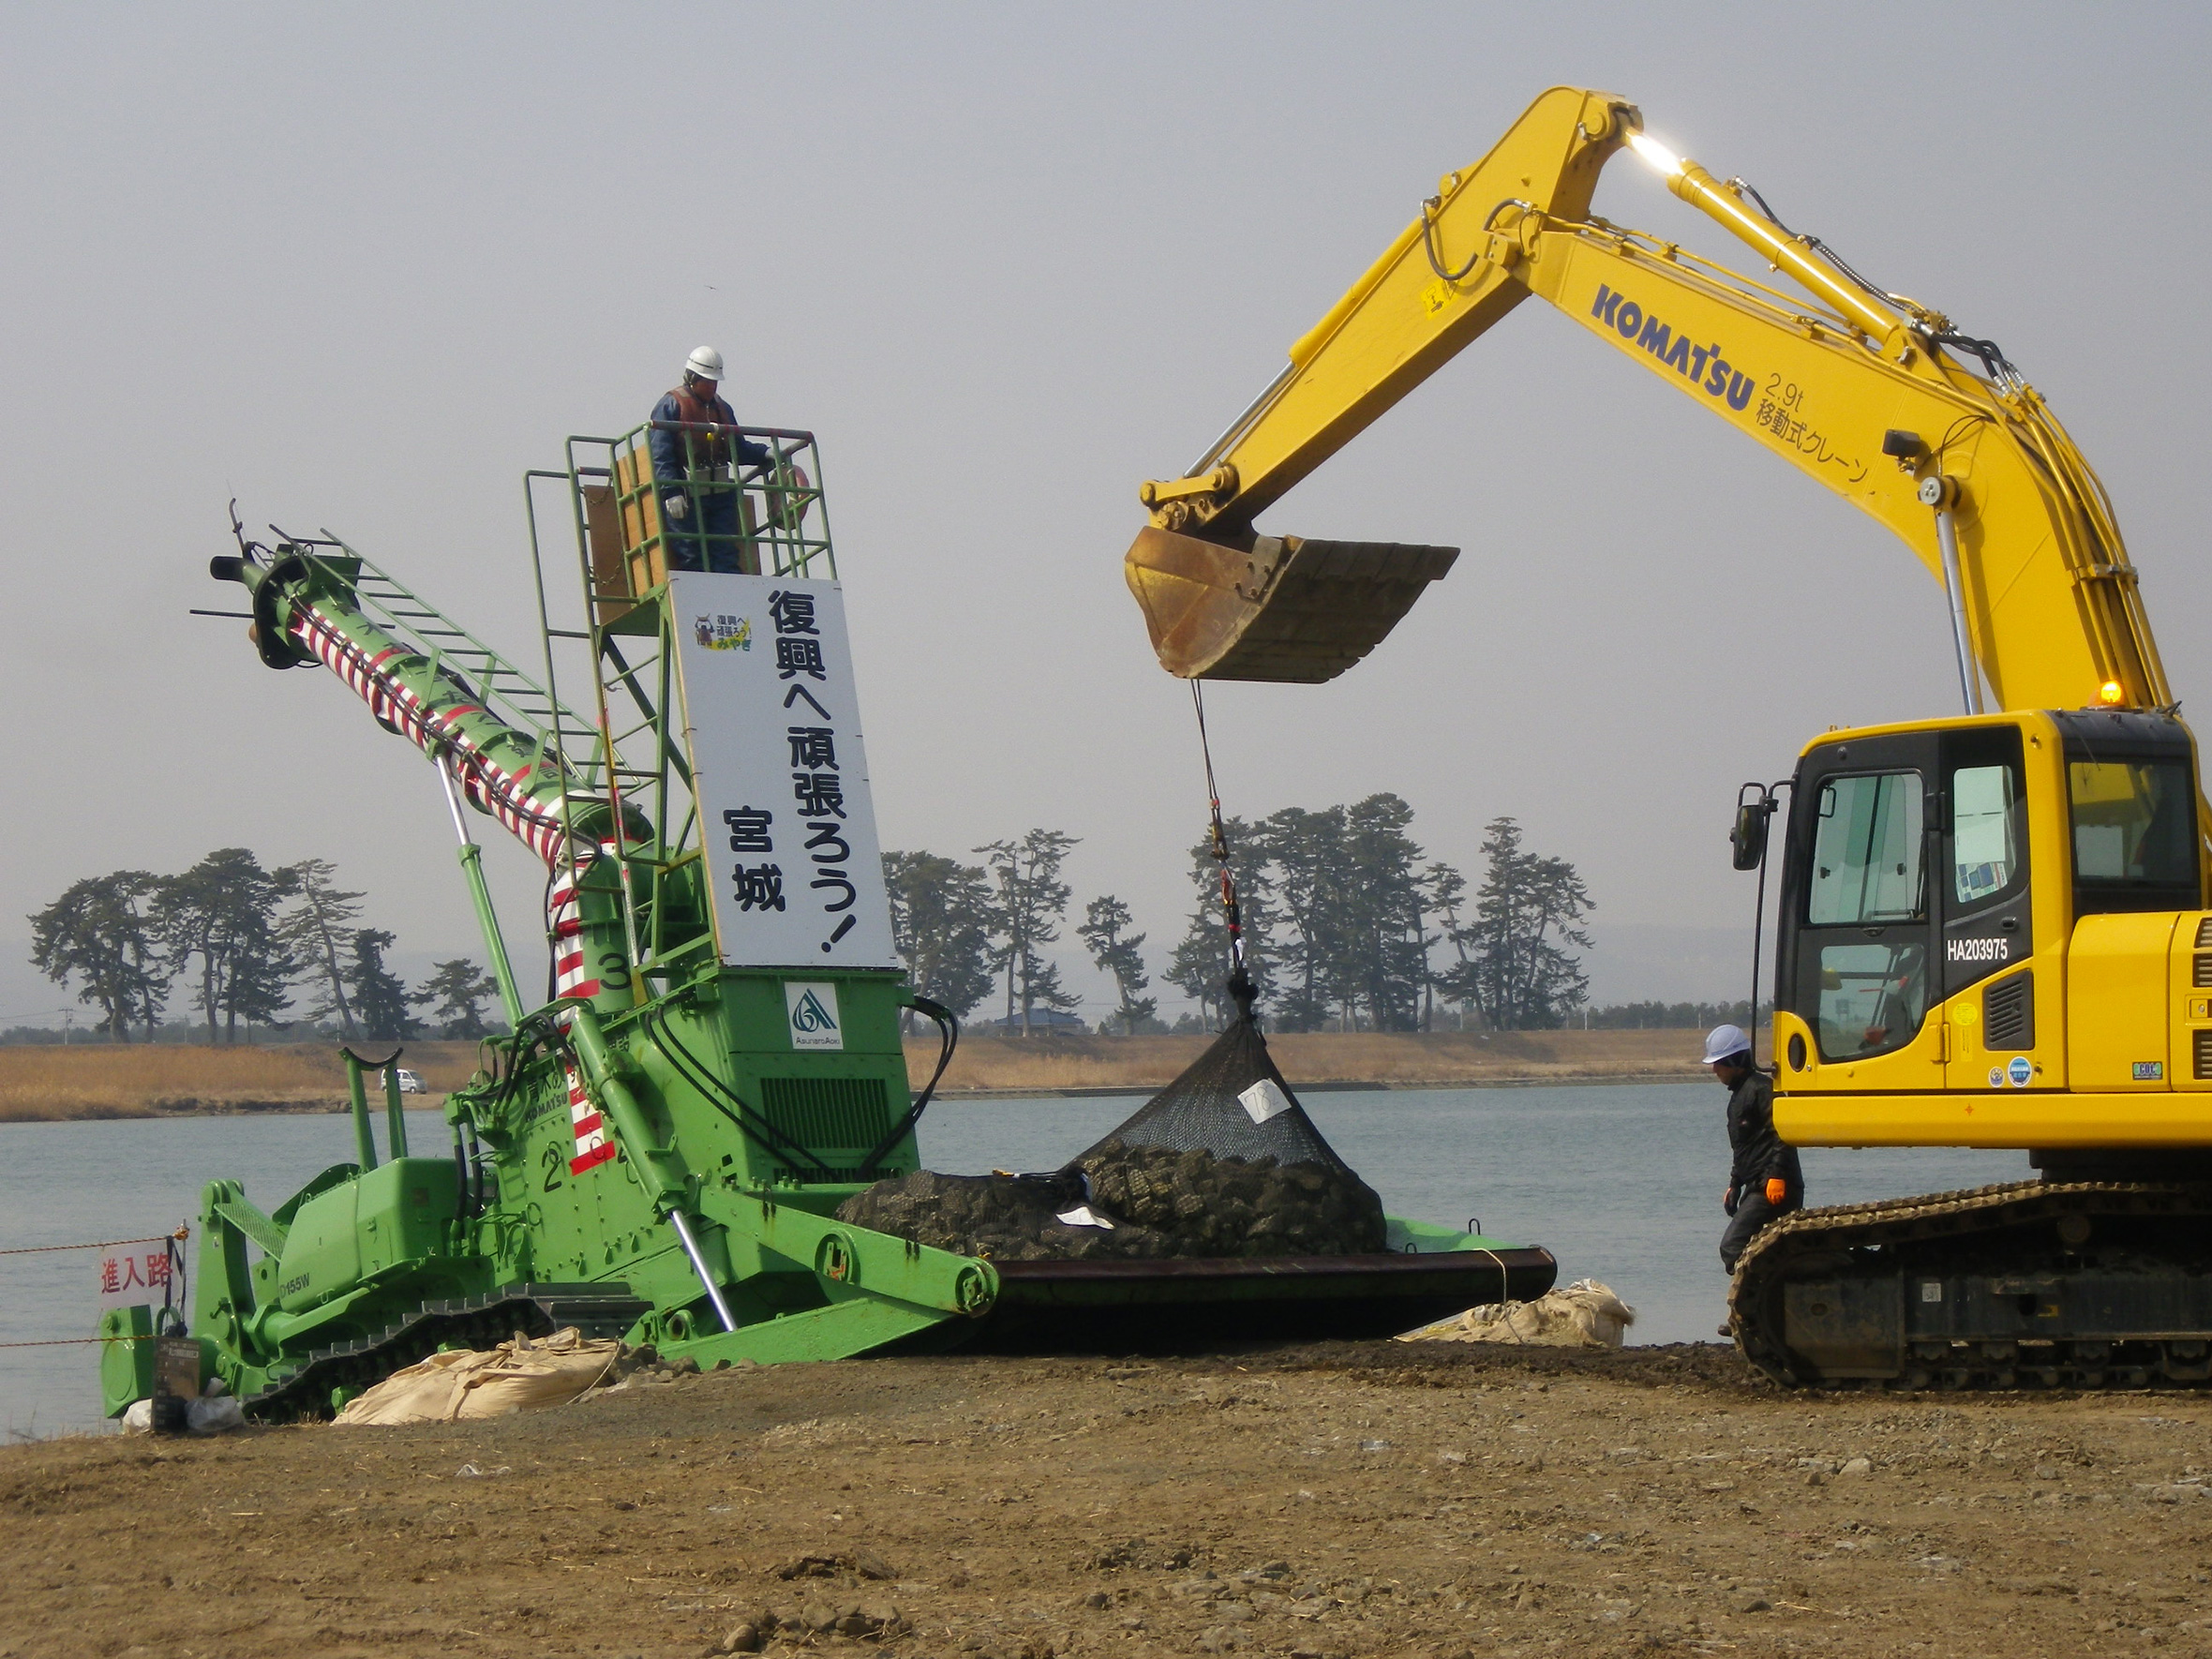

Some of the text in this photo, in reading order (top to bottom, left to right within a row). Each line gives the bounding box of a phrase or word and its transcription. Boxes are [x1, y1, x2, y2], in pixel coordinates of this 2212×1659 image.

[1591, 283, 1756, 411] KOMATSU
[1765, 372, 1803, 412] 2.9t
[1756, 398, 1868, 483] 移動式クレーン
[723, 805, 785, 912] 宮城
[1947, 938, 2008, 961] HA203975
[598, 952, 632, 990] 3
[542, 1149, 562, 1193] 2
[101, 1252, 173, 1293] 進入路
